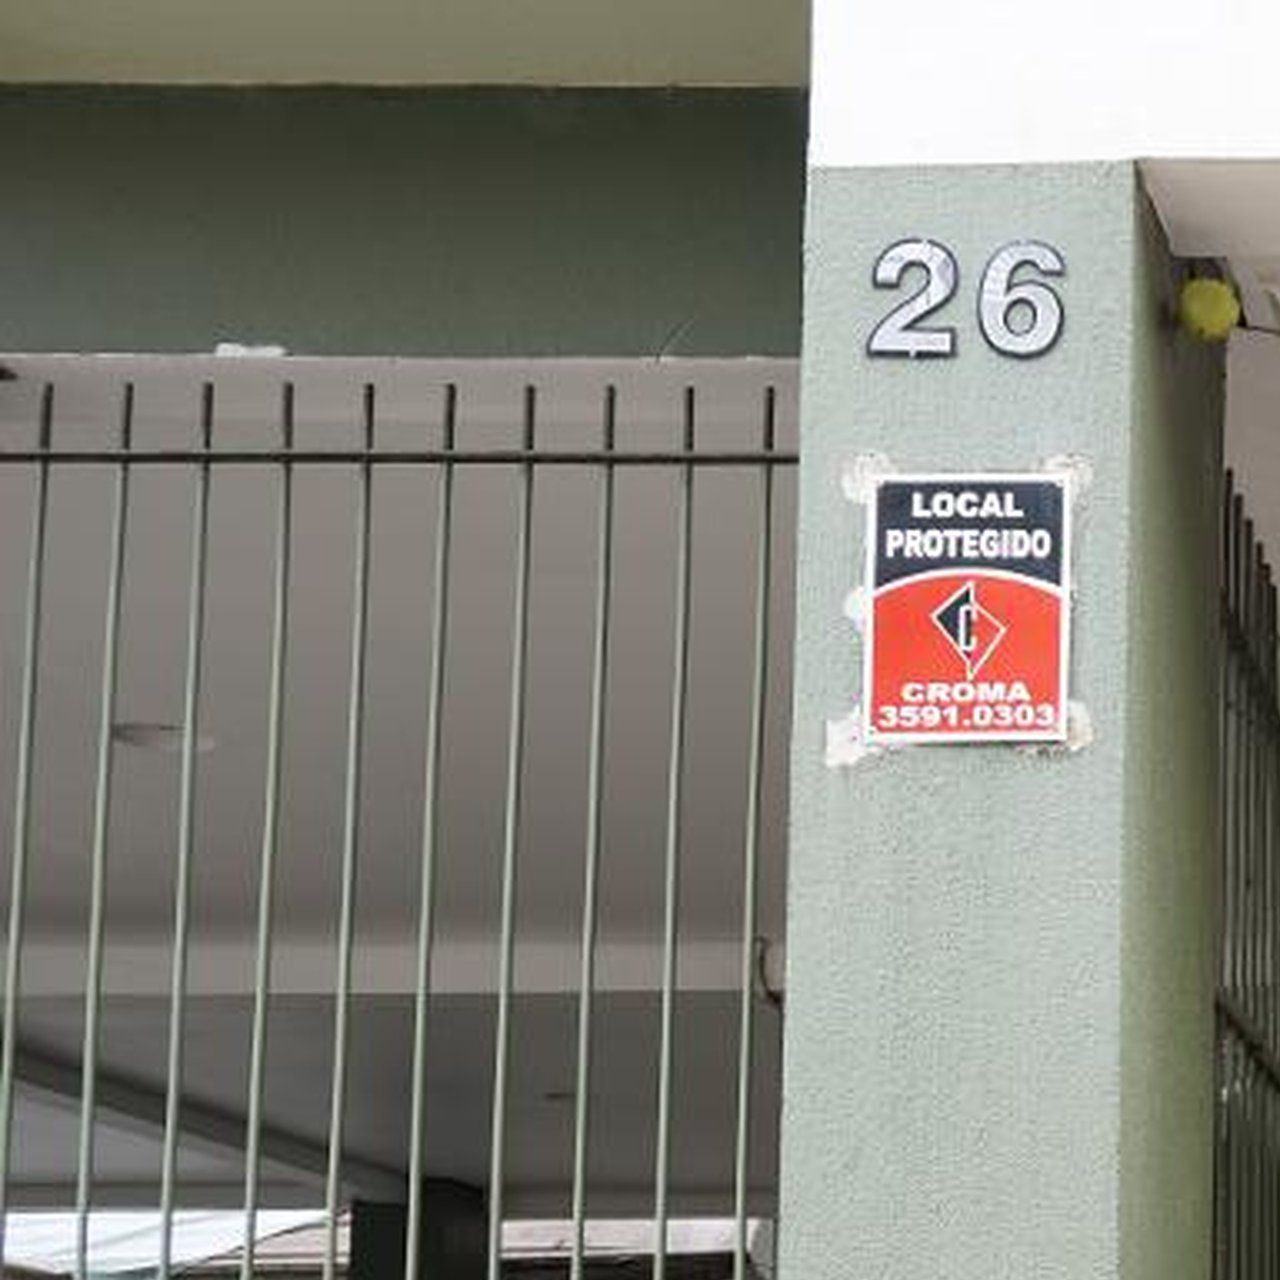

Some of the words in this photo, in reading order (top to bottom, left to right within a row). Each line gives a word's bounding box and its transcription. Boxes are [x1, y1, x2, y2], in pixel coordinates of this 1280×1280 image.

[867, 239, 1066, 359] 26
[911, 491, 1024, 518] LOCAL
[886, 528, 1051, 559] PROTEGIDO
[901, 682, 1031, 702] CROMA
[879, 705, 1055, 727] 3591.0303
